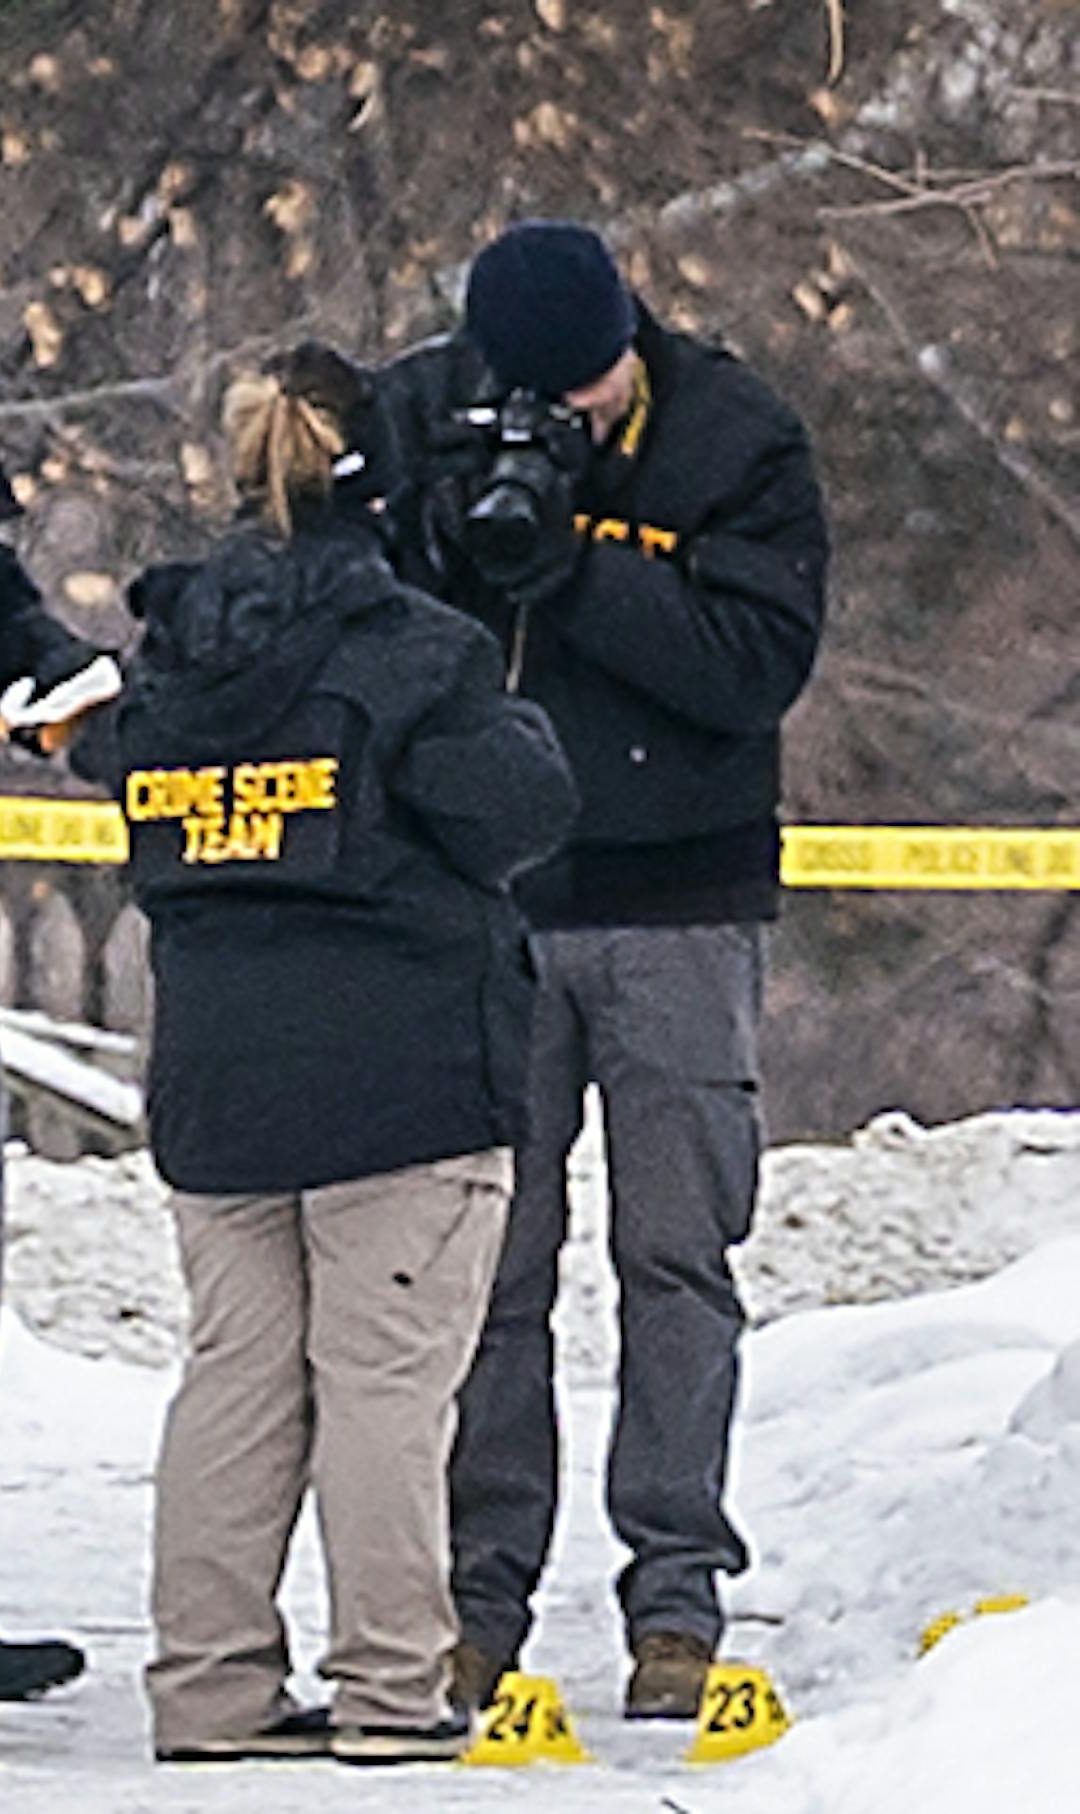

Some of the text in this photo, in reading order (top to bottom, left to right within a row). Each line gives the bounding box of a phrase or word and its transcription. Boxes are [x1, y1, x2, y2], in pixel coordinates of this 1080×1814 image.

[127, 758, 338, 820] CRIME SCENE
[182, 813, 282, 863] TEAM
[488, 1694, 537, 1742] 24
[709, 1681, 756, 1732] 23
